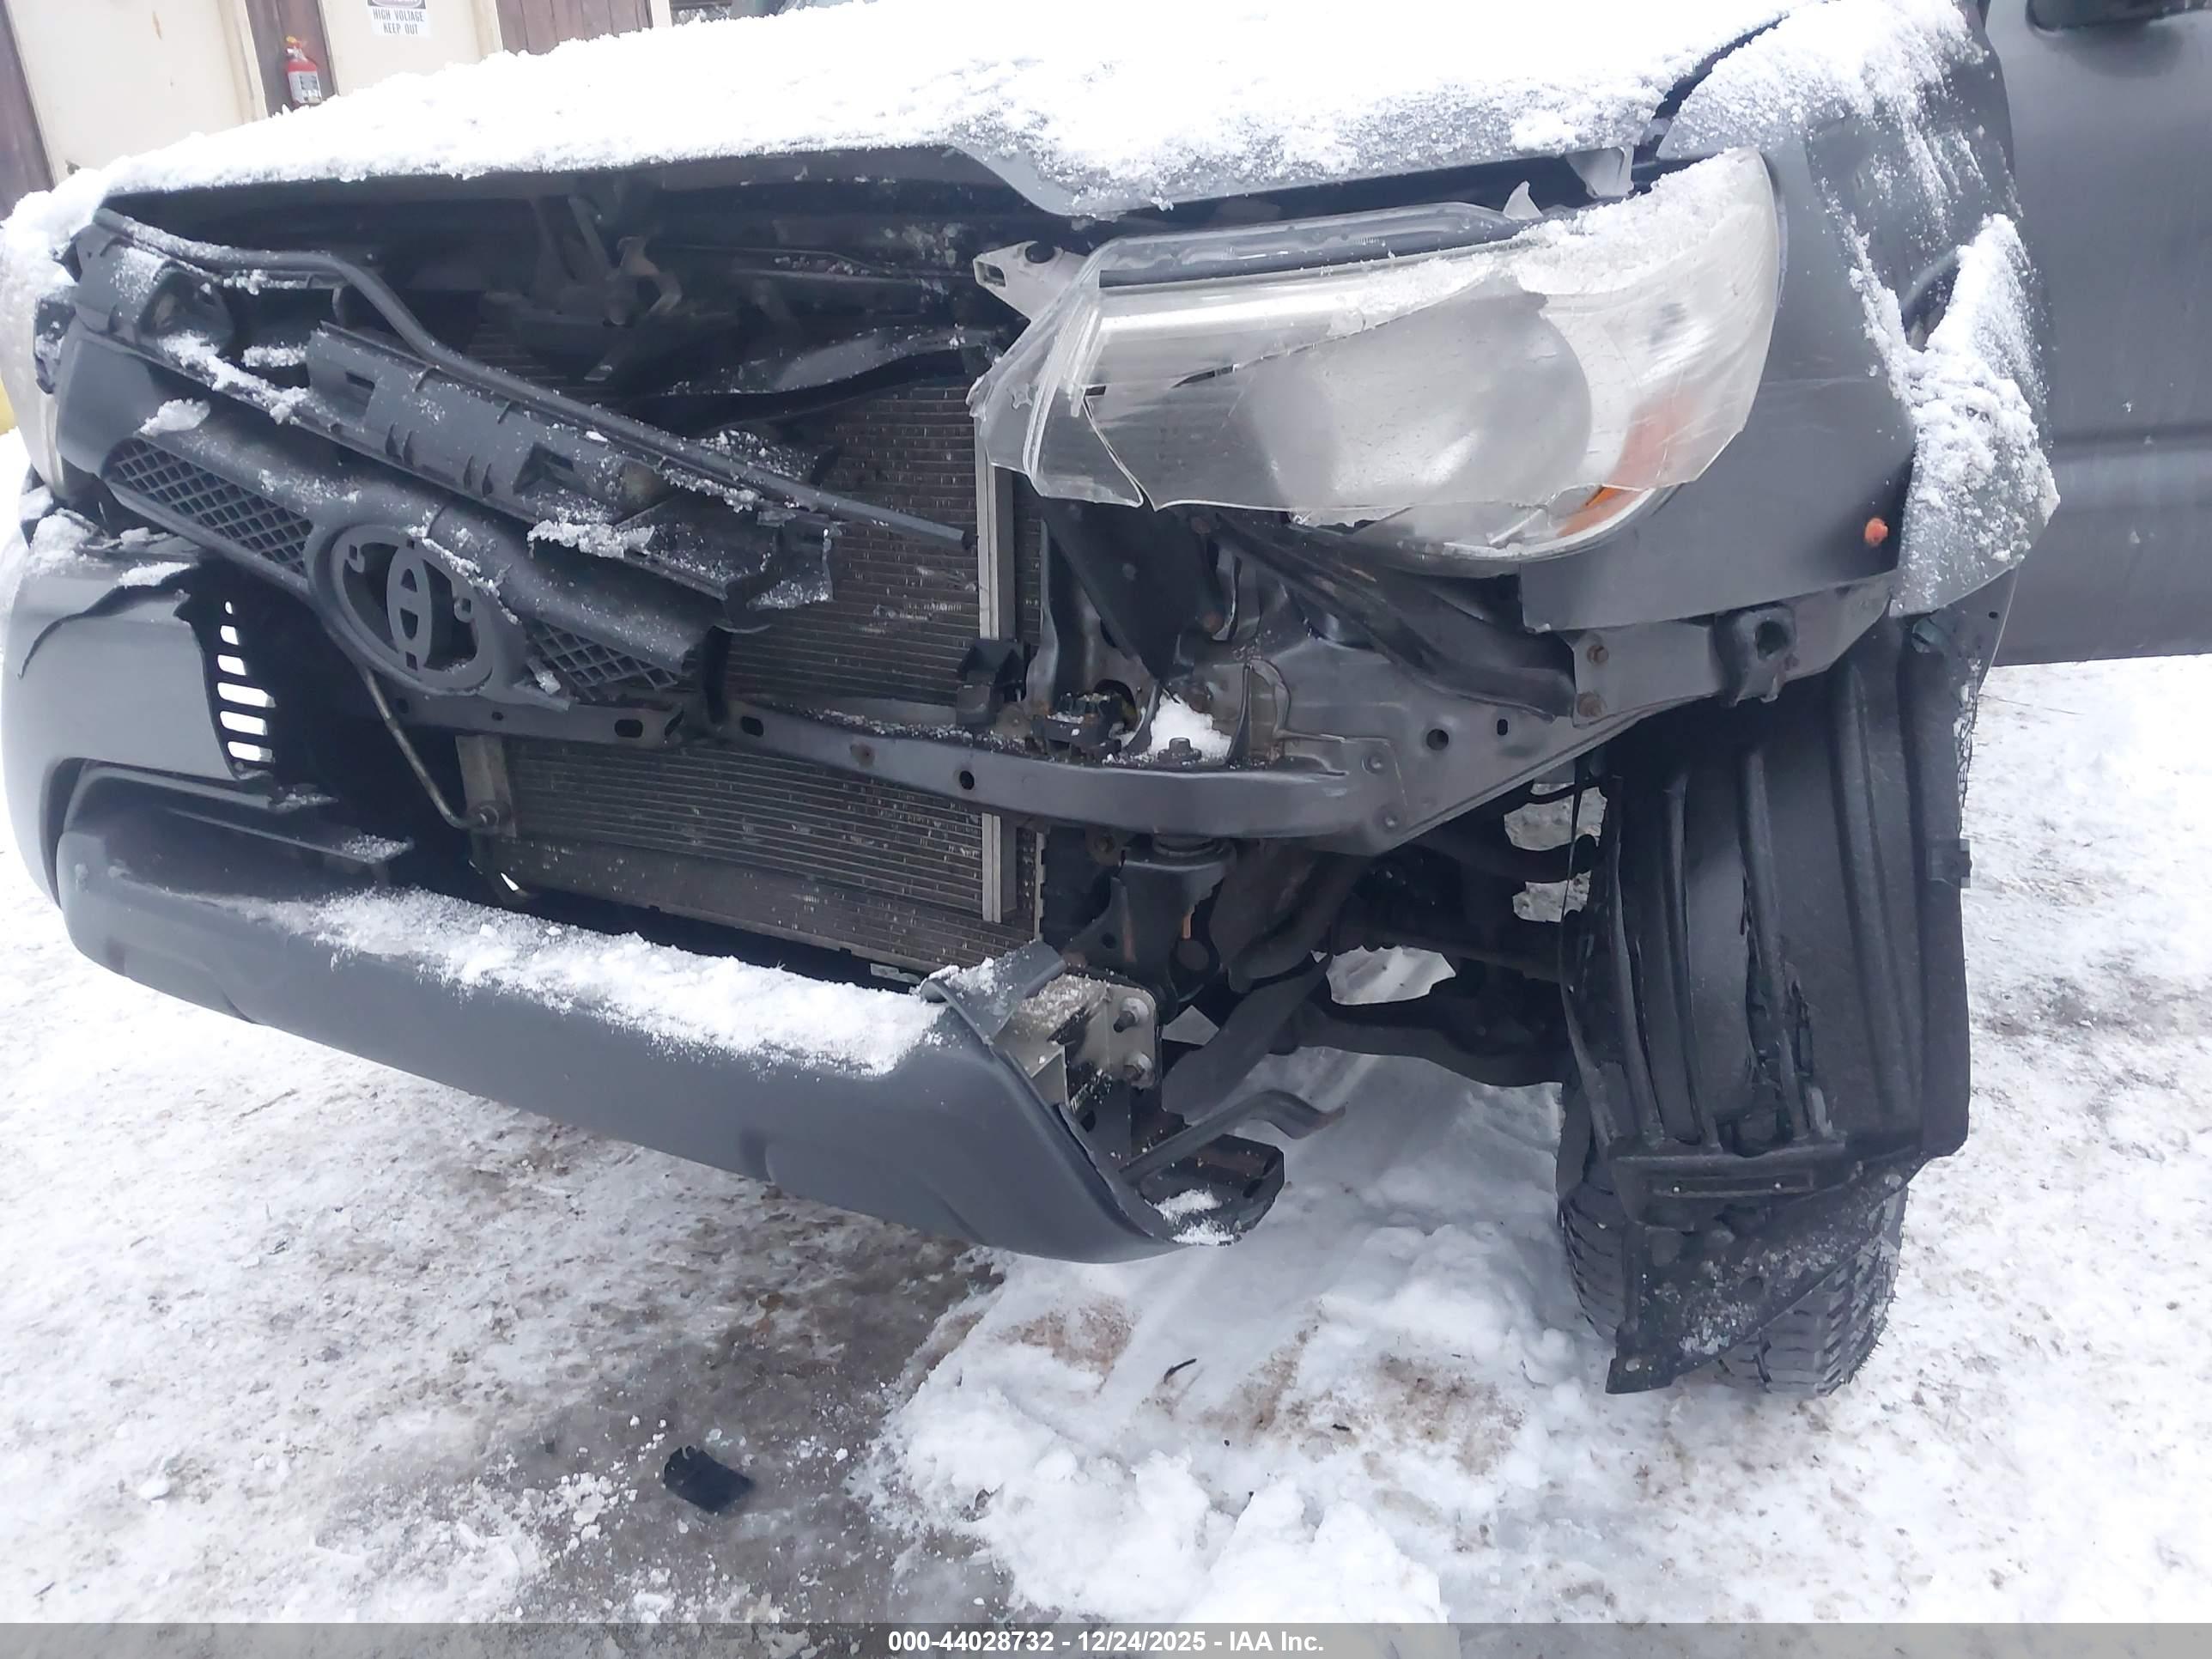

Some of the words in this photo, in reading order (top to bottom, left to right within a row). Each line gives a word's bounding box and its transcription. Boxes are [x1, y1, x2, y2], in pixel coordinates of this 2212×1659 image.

[373, 9, 391, 21] HIGH
[394, 9, 424, 21] VOLTAGE
[384, 22, 401, 34] KEEP
[404, 23, 418, 34] OUT
